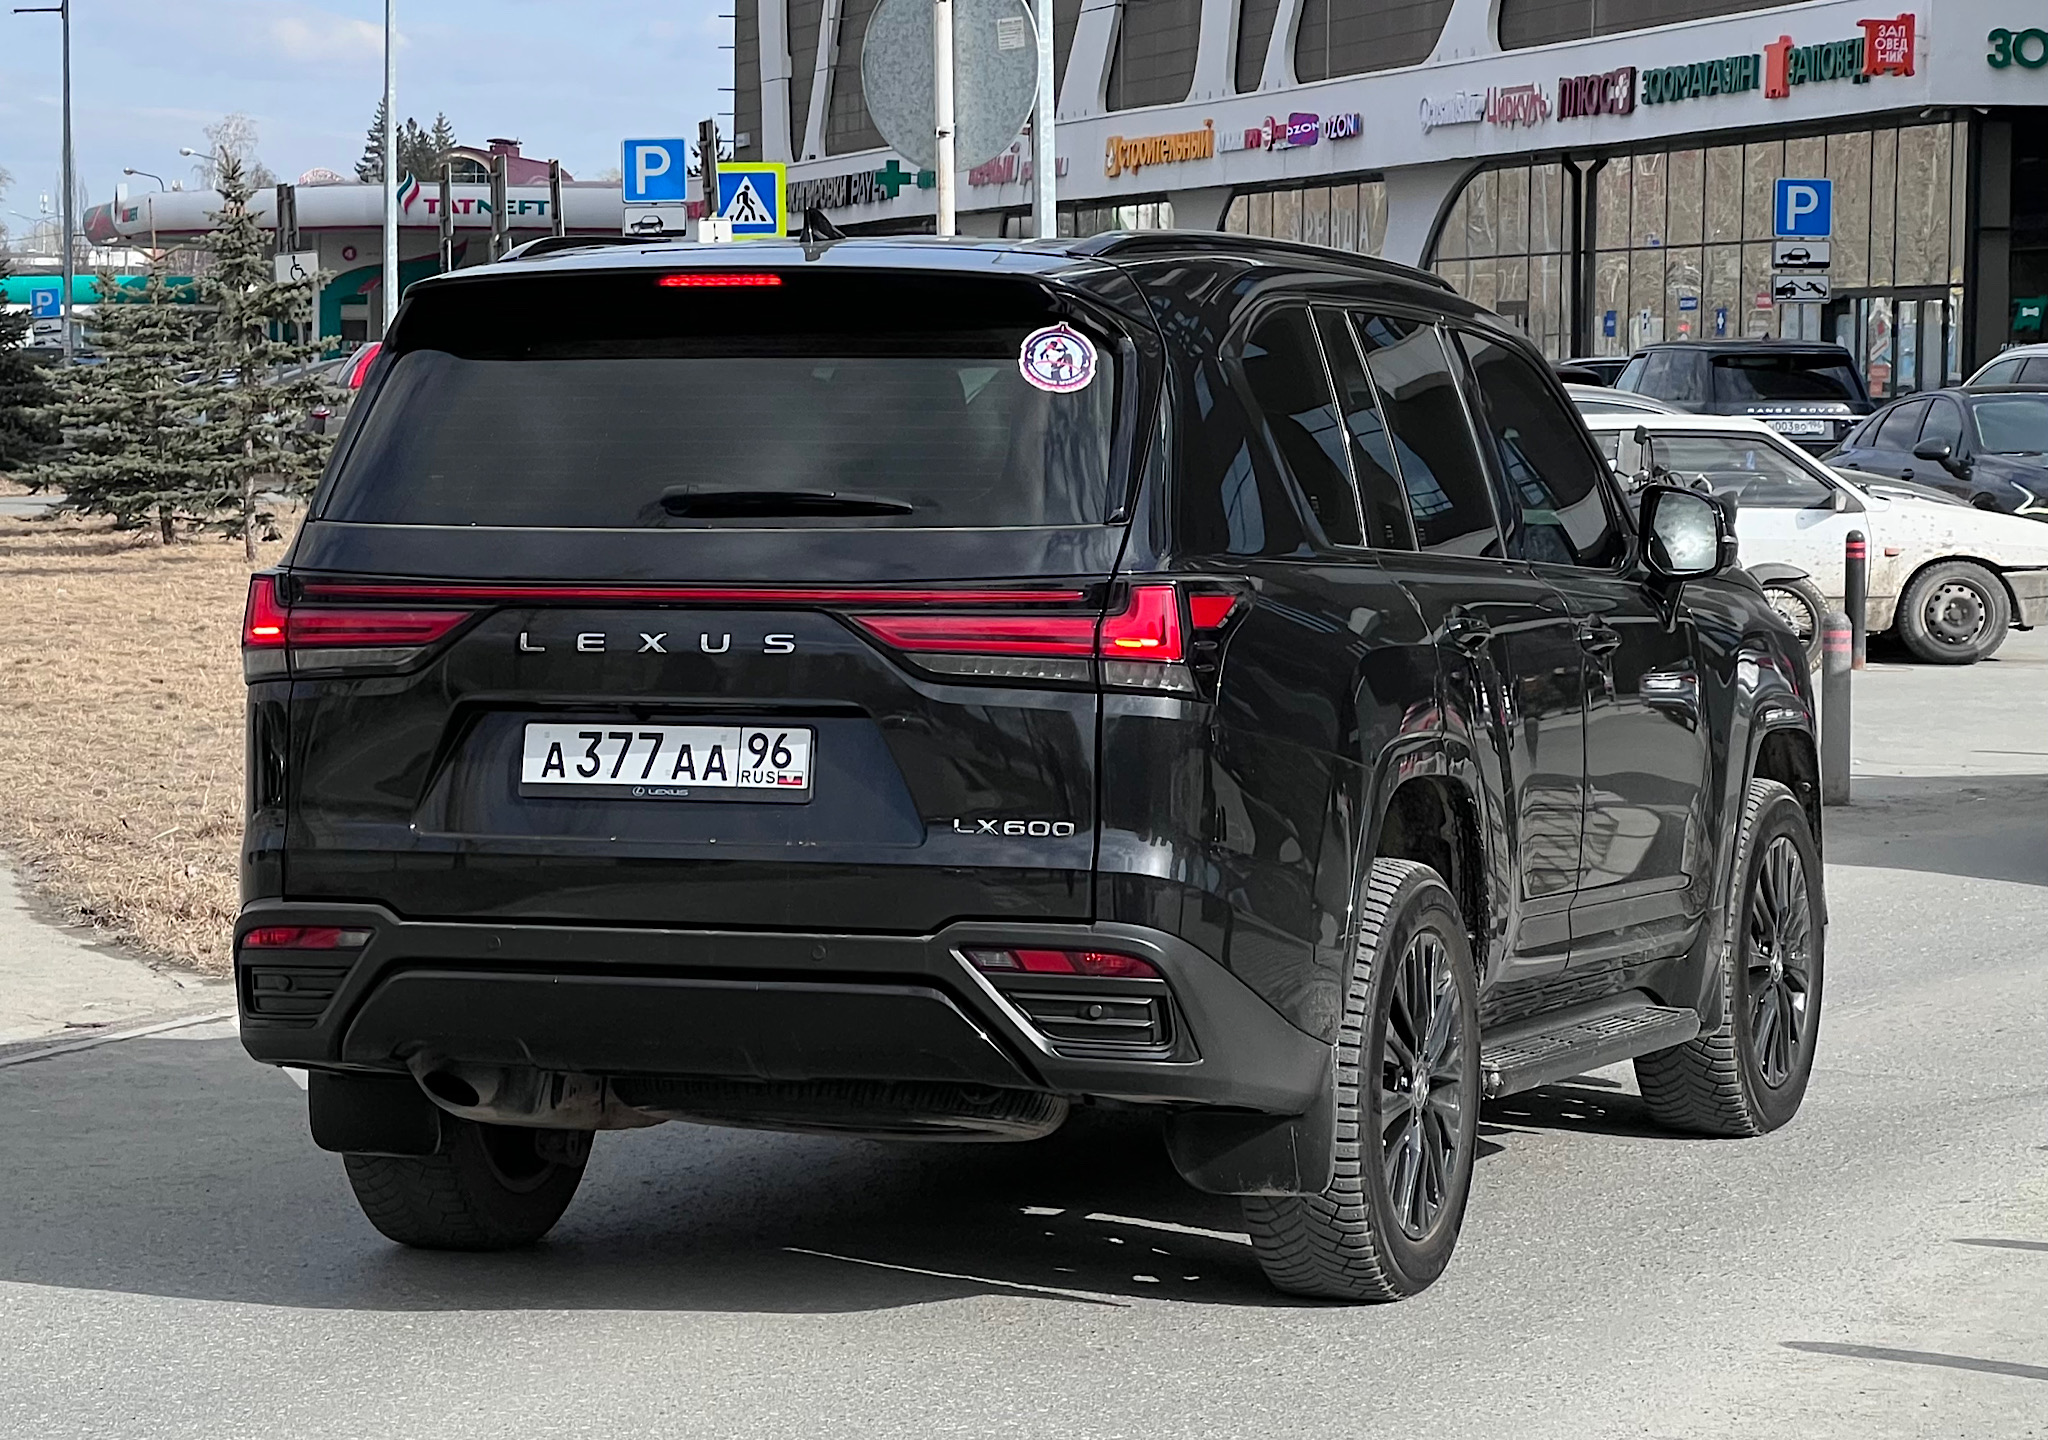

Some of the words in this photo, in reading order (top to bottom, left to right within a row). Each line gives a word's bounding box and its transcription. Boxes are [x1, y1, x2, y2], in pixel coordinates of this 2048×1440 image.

[1877, 24, 1906, 38] ЗАП
[1874, 37, 1909, 52] ОВЕД
[1877, 49, 1904, 63] НИК
[1641, 54, 1761, 105] ЗООМАГАЗИН
[1557, 73, 1616, 121] ПЛЮС
[636, 145, 671, 194] P
[786, 173, 848, 214] КИПИРОВКИ
[1786, 185, 1819, 230] P
[36, 291, 53, 315] P
[519, 632, 796, 654] LEXUS
[541, 732, 728, 781] А377АА
[748, 732, 792, 769] 96
[741, 770, 775, 784] RUS
[648, 788, 689, 796] LEXUS
